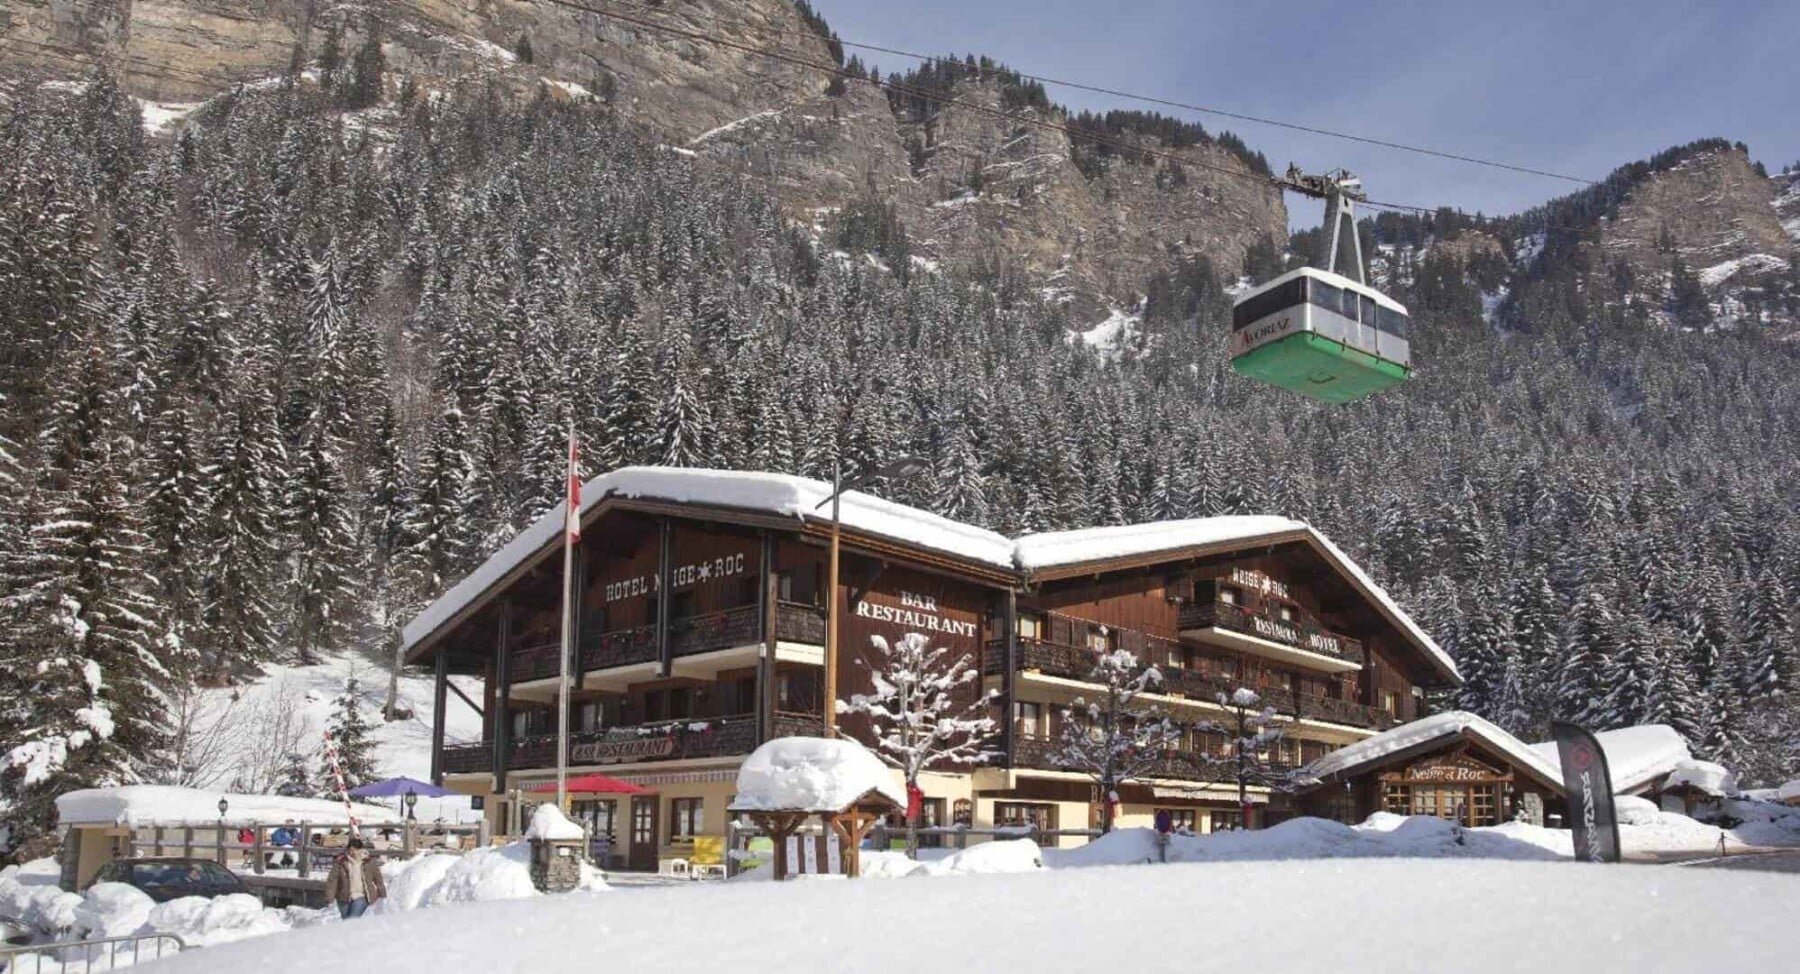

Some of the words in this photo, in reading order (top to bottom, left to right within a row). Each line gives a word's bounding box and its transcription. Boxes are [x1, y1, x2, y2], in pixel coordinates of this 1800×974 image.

[606, 576, 648, 602] HOTEL
[653, 565, 696, 591] NIGE
[715, 553, 744, 578] ROC
[856, 600, 977, 637] RESTAURANT
[901, 590, 938, 612] BAR
